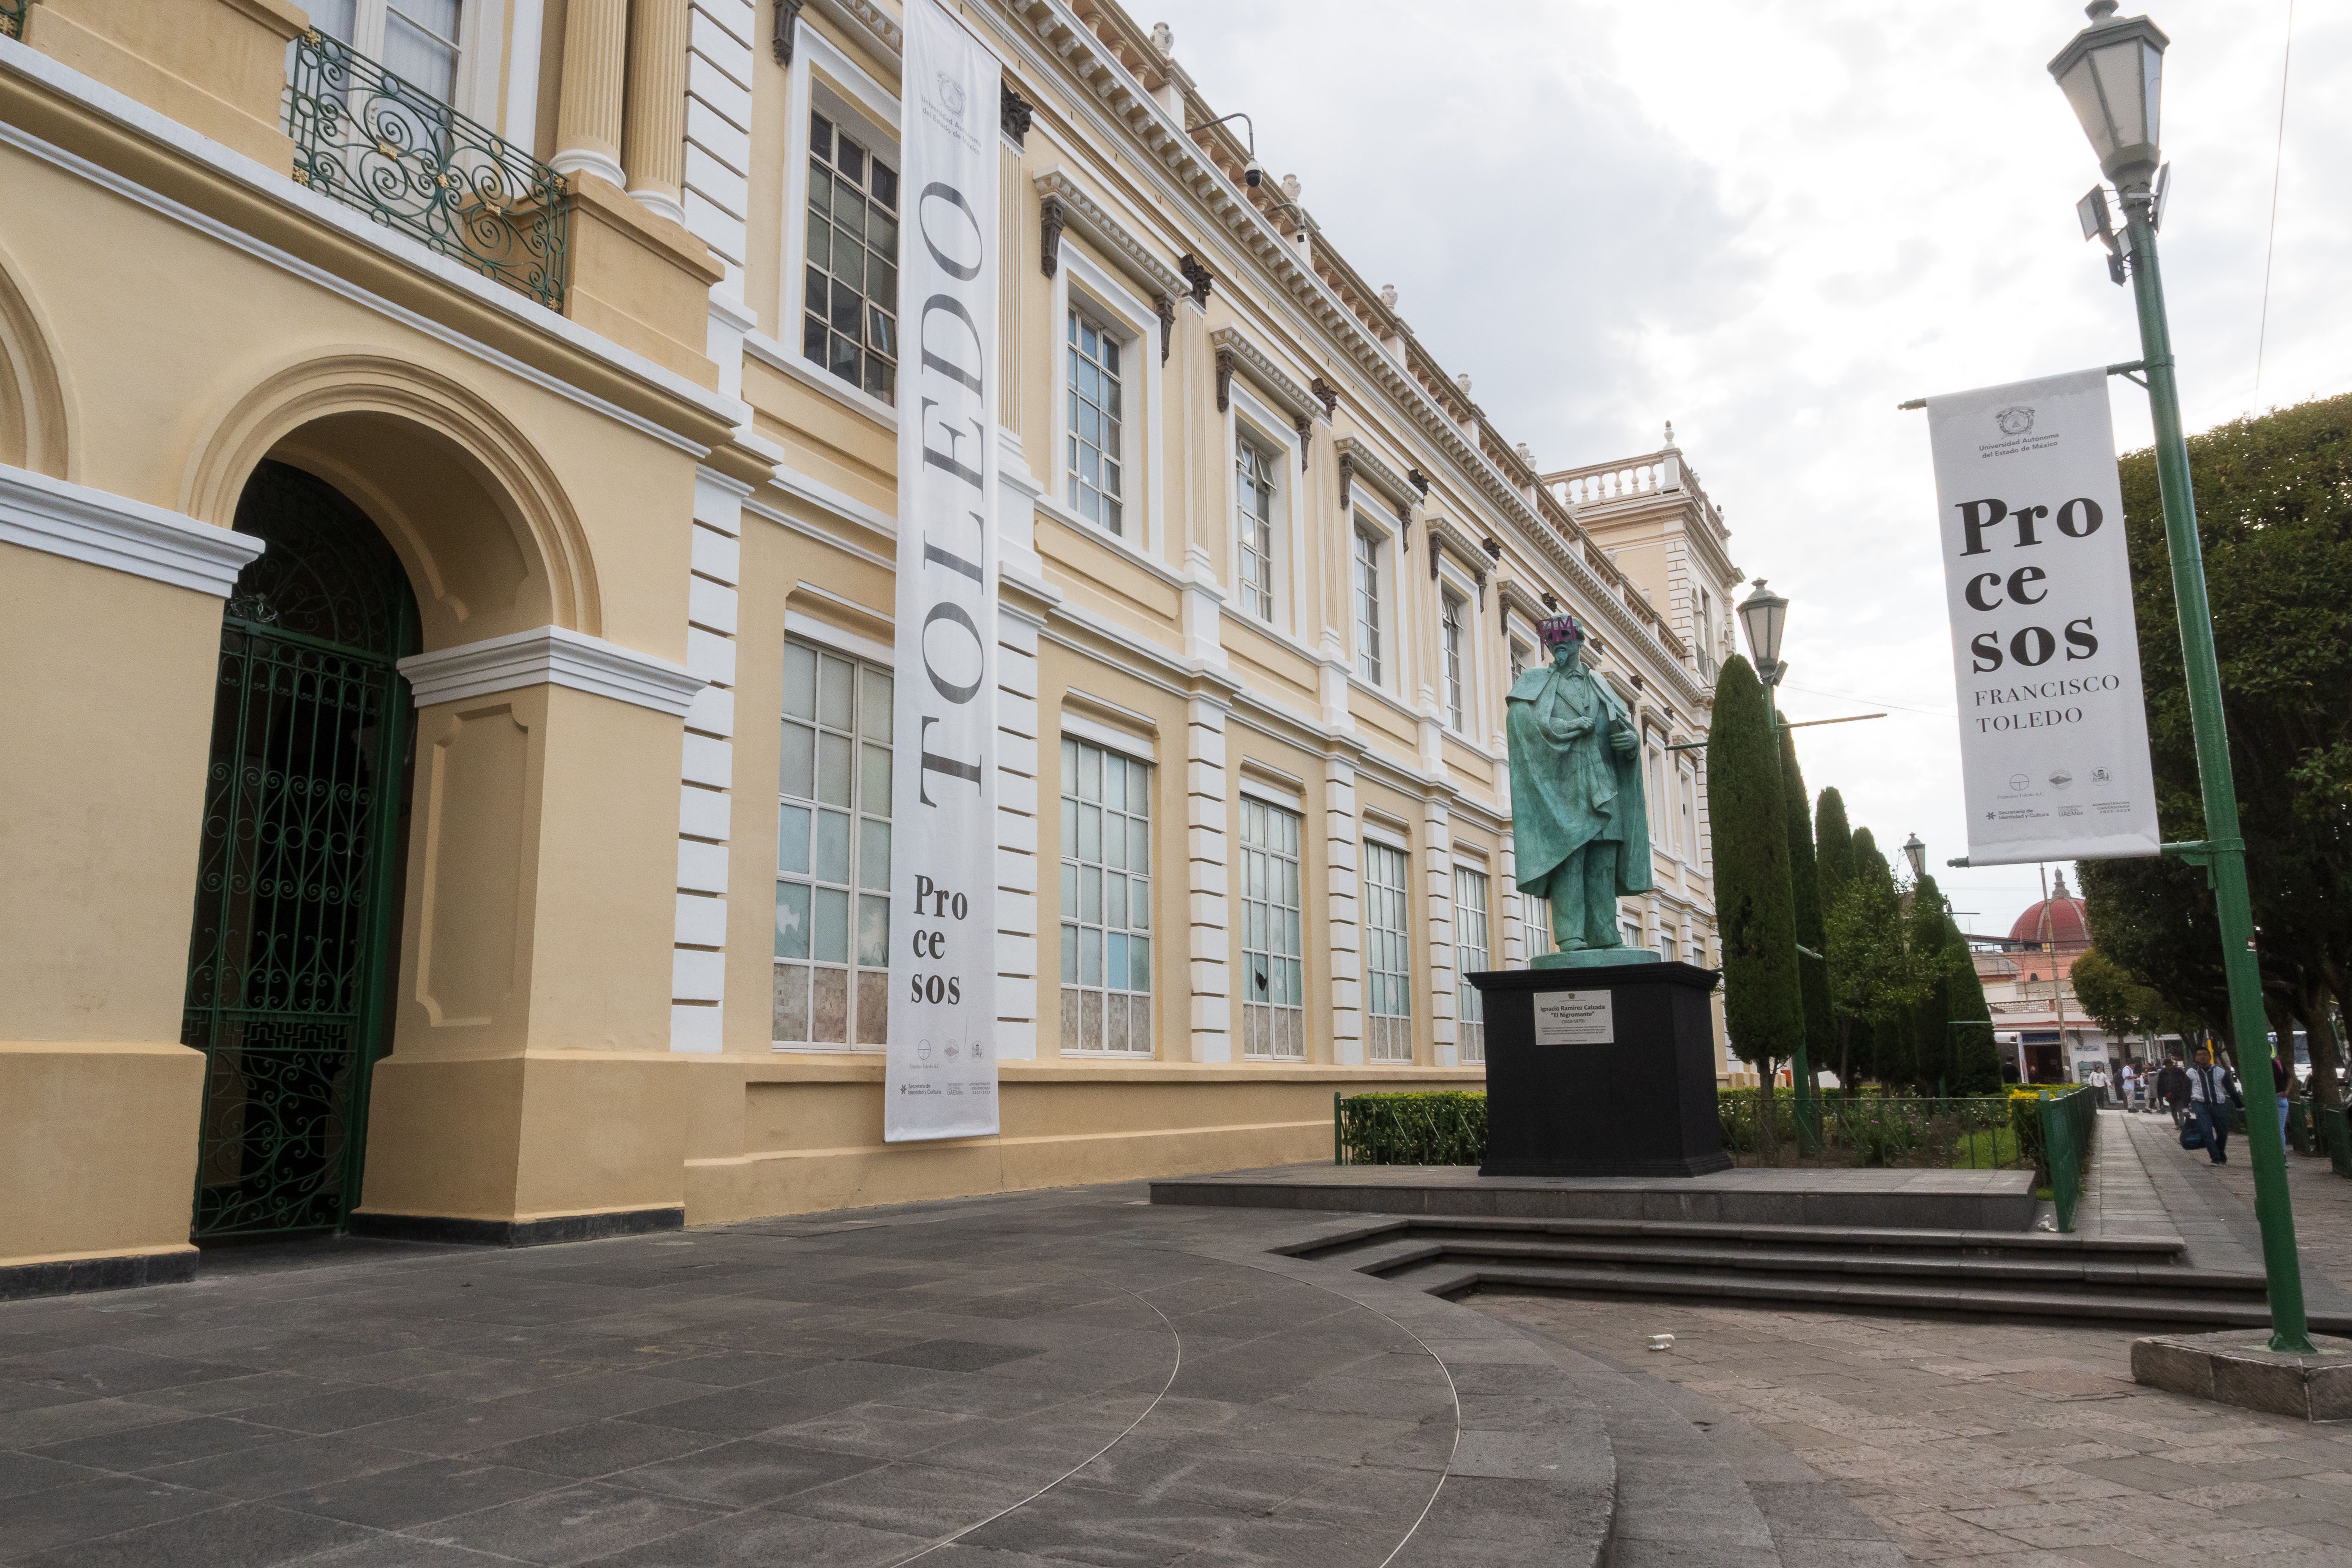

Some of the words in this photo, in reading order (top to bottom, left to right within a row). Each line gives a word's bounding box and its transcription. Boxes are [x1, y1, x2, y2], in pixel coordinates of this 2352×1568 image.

[921, 95, 953, 125] Universidad
[923, 107, 932, 118] del
[933, 114, 951, 134] Estado
[953, 131, 961, 139] de
[1979, 439, 2020, 451] Universidad
[2023, 433, 2059, 443] Autónoma
[1995, 448, 2019, 456] Estado
[2032, 441, 2058, 449] México
[919, 182, 984, 810] TOLEDO
[1955, 498, 2103, 556] Pro
[1965, 566, 2047, 611] ce
[1971, 616, 2098, 674] sos
[1975, 675, 2120, 706] FRANCISCO
[1976, 707, 2082, 732] TOLEDO
[914, 874, 968, 920] Pro
[913, 929, 945, 959] ce
[911, 974, 960, 1005] sos
